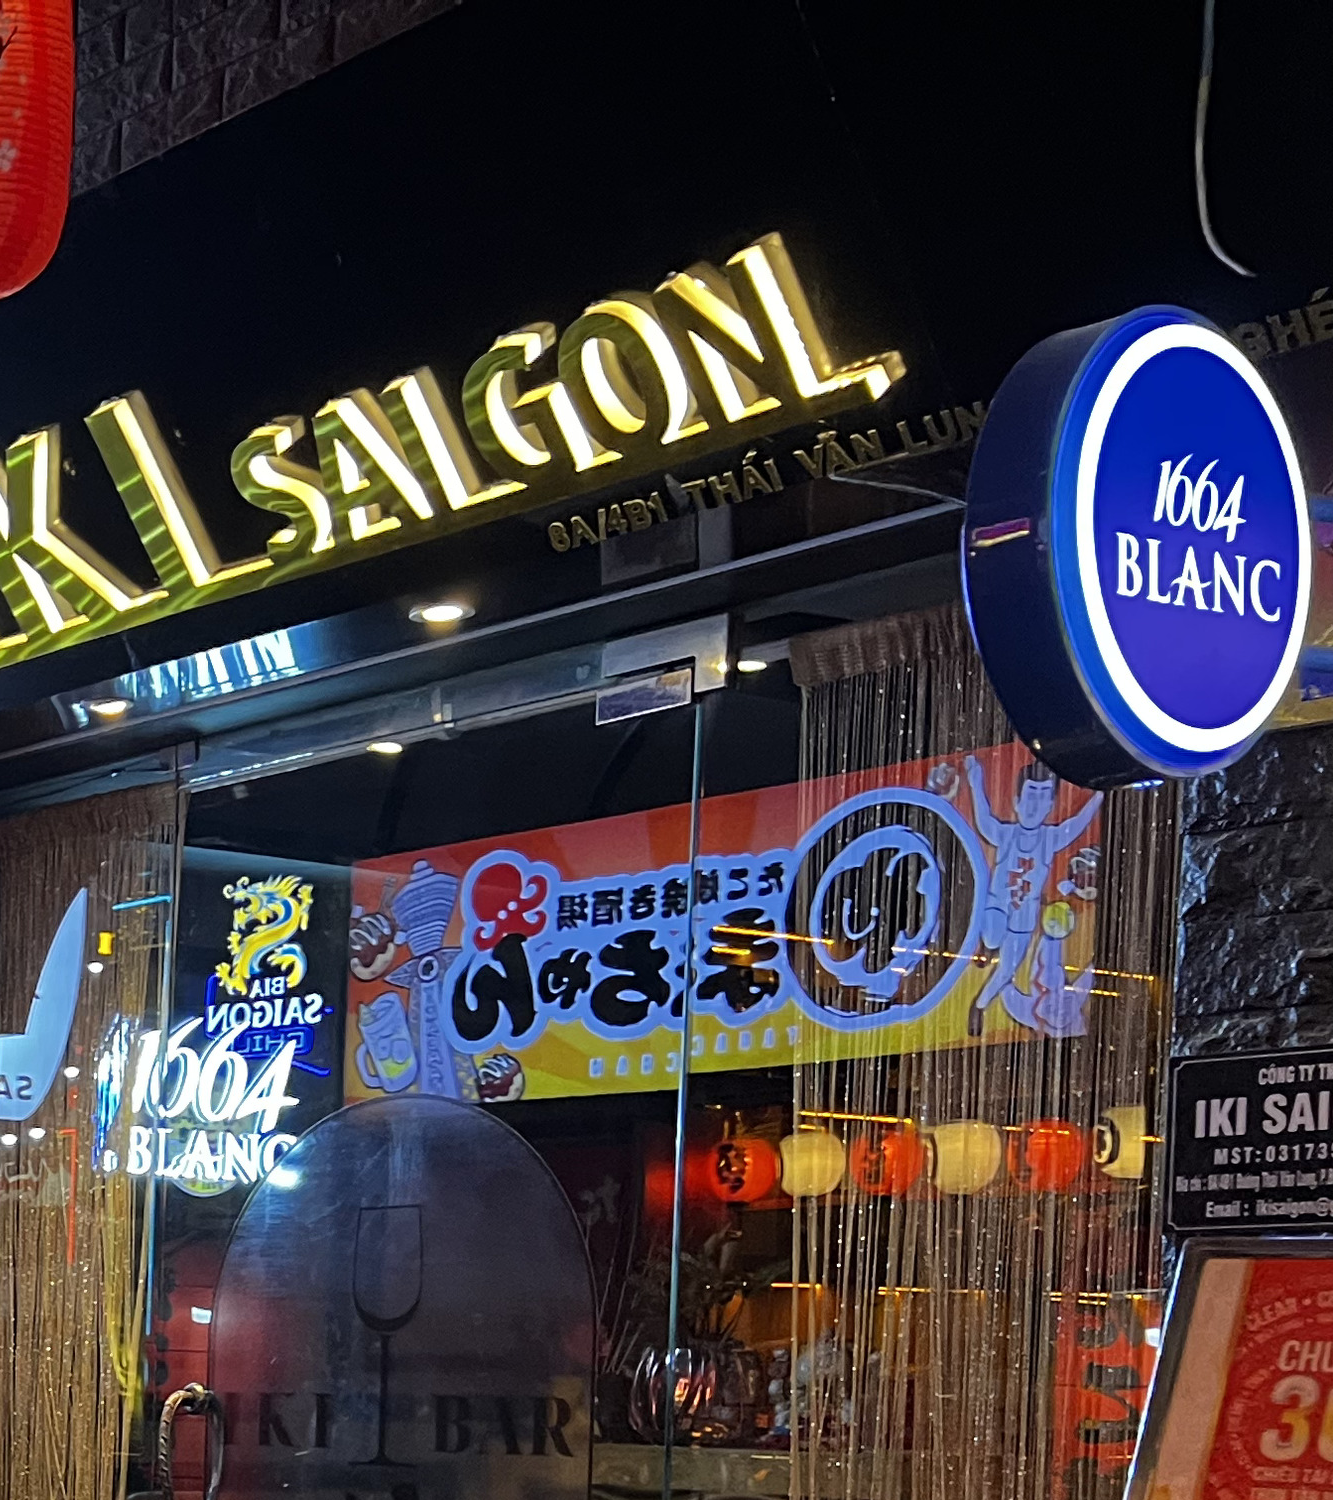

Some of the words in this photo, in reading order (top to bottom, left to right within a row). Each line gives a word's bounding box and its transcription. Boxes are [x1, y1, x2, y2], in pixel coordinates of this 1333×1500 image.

[232, 232, 907, 560] SAIGON
[547, 491, 669, 552] 8A/4B1
[681, 450, 785, 510] THÁI
[1153, 454, 1247, 543] 1664
[1116, 532, 1281, 622] BLANC
[132, 1016, 301, 1134] 1664
[1194, 1097, 1247, 1138] IKI
[1262, 1091, 1331, 1134] SAI
[1299, 1064, 1315, 1081] TY
[126, 1125, 299, 1184] BLANC
